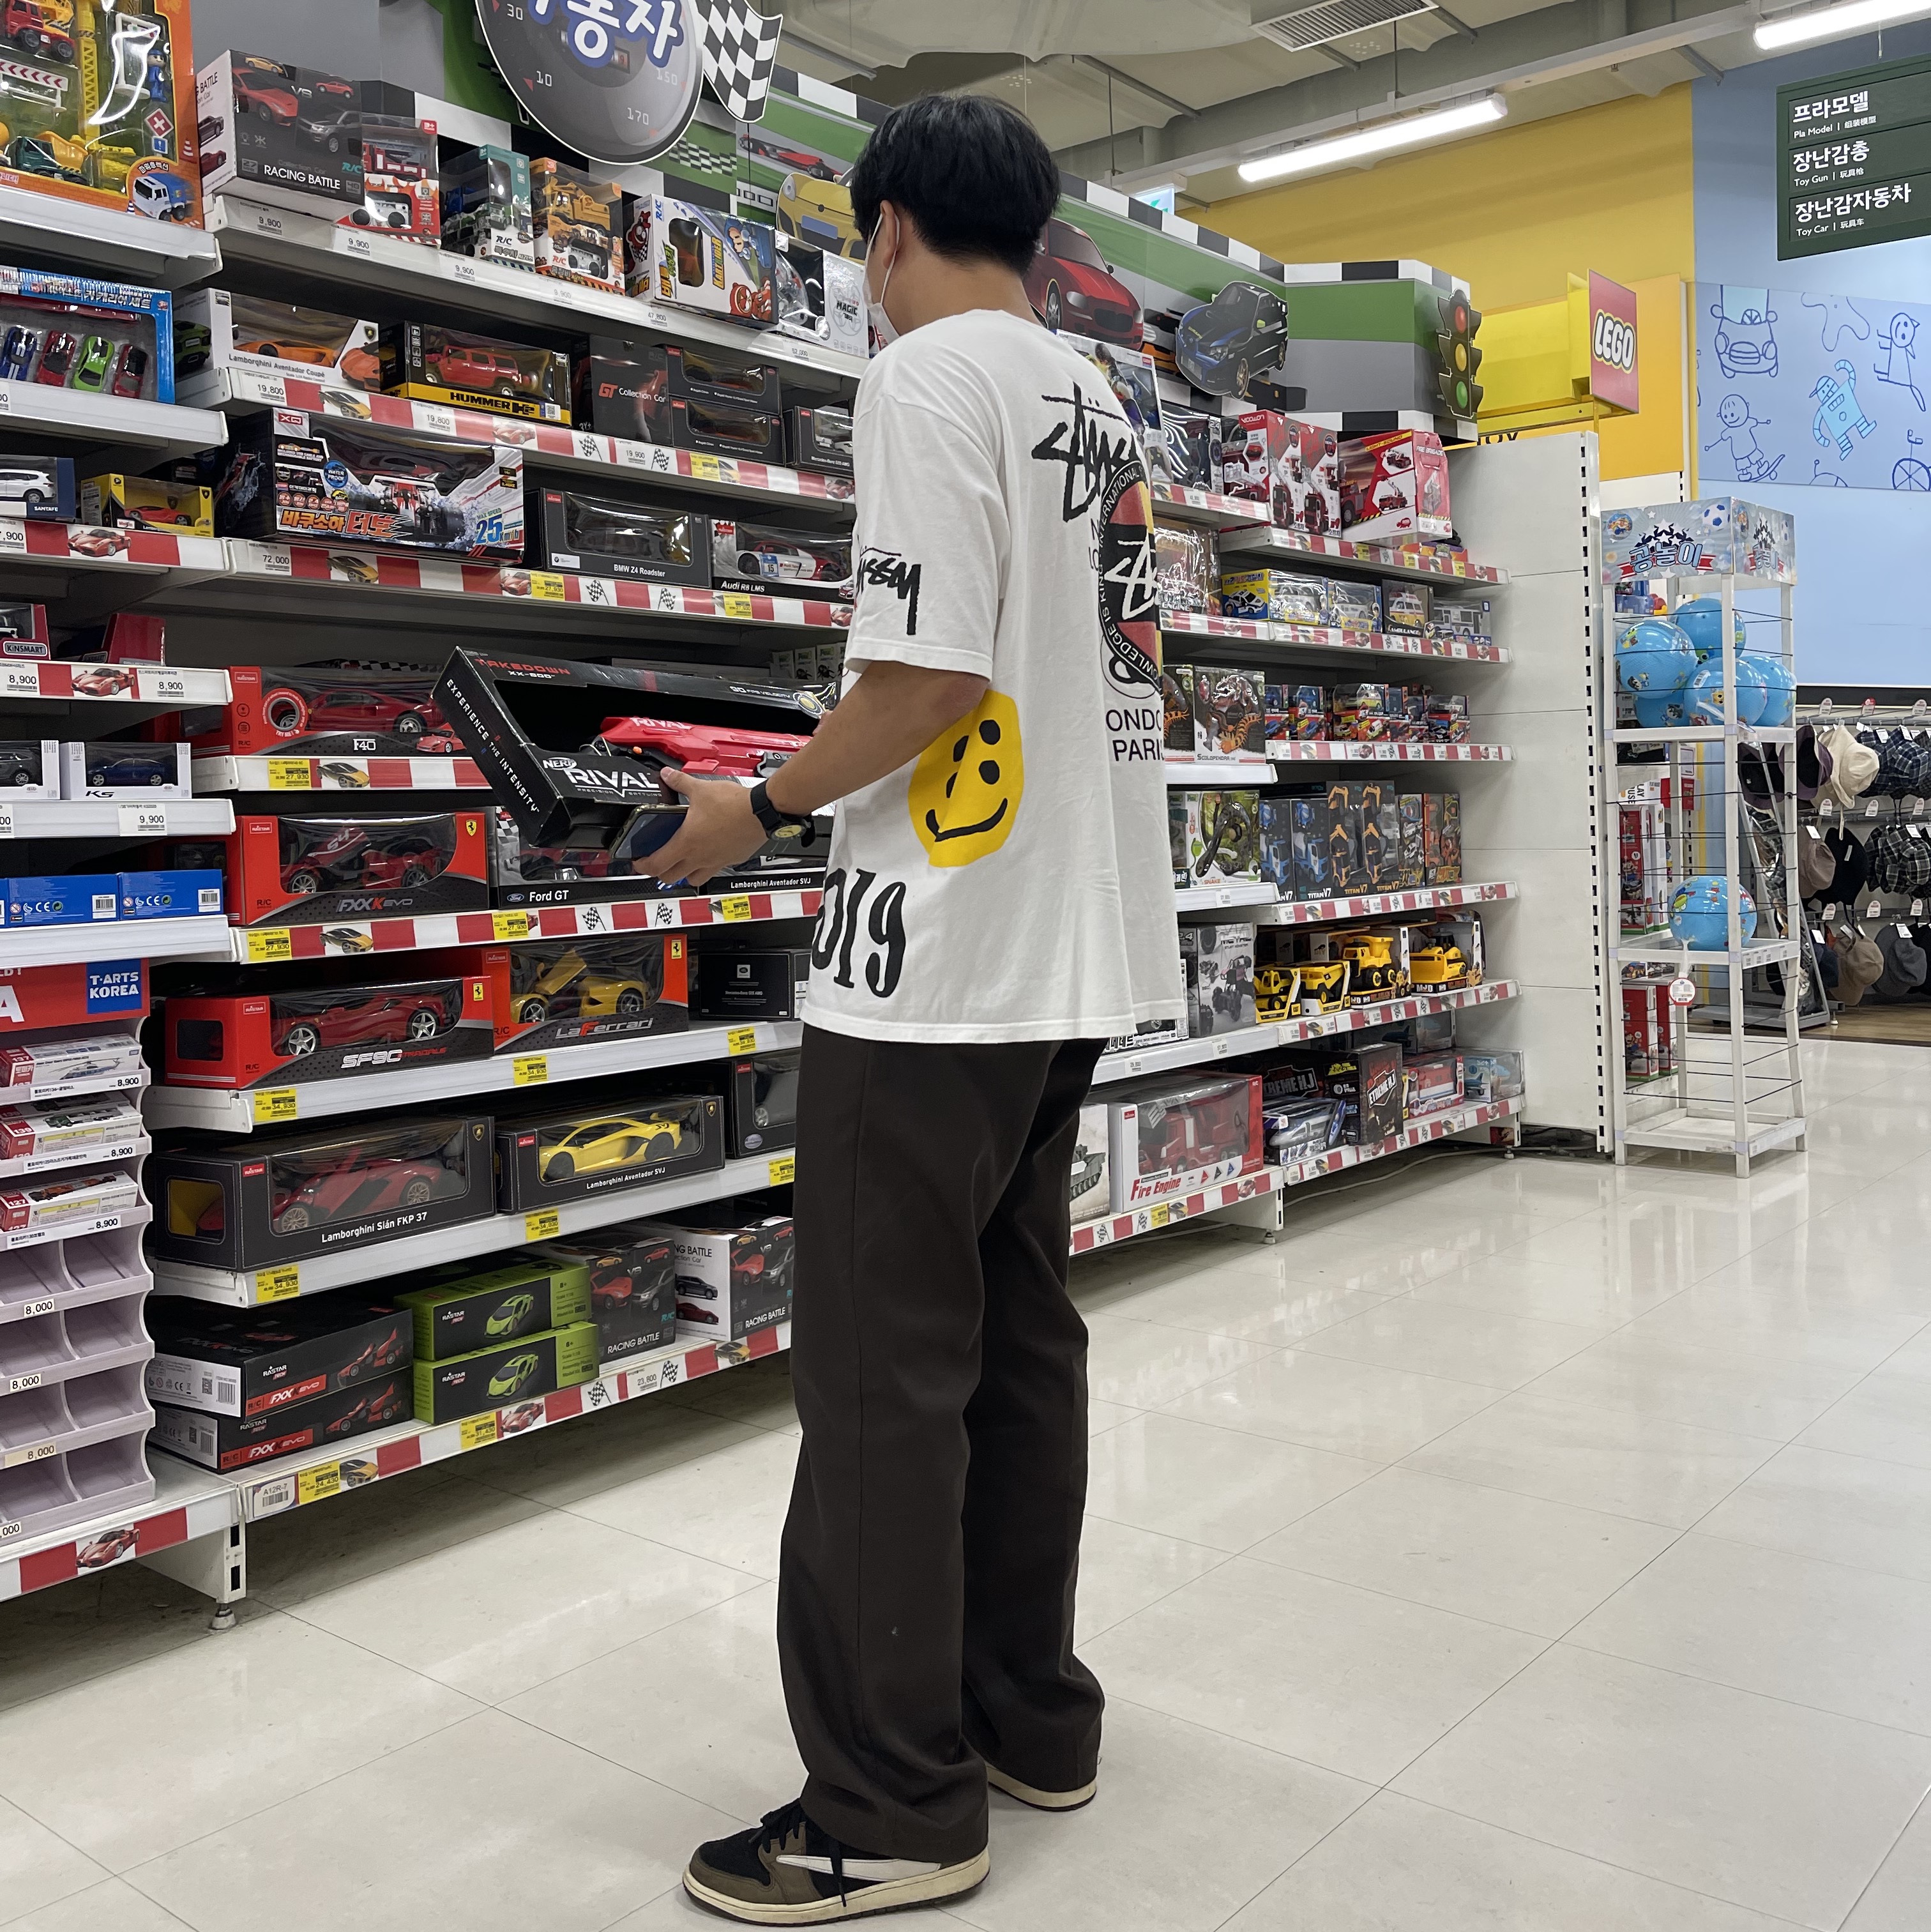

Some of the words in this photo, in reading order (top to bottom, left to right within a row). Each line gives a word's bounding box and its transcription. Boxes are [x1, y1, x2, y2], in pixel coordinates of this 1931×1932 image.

[507, 4, 523, 20] 30
[200, 72, 218, 94] BATTLE
[536, 70, 552, 87] 10
[656, 68, 678, 86] 150
[1792, 90, 1869, 123] 프라모델
[627, 107, 649, 125] 170
[1808, 124, 1833, 135] Model
[1793, 140, 1870, 172] 장난감총
[264, 164, 306, 181] RACING
[308, 173, 341, 190] BATTLE
[1794, 178, 1810, 187] Toy
[1812, 174, 1829, 184] Gun
[1795, 183, 1912, 223] 장난감자동차
[1796, 228, 1812, 237] Toy
[1814, 224, 1829, 234] Car
[496, 235, 512, 245] R/C
[552, 255, 566, 265] R/C
[837, 302, 858, 317] MAGIC
[1594, 315, 1635, 369] LEGO
[229, 353, 273, 370] Lamborghini
[274, 362, 305, 374] Aventador
[307, 367, 326, 378] Coupé
[257, 384, 284, 395] 19,800
[599, 383, 618, 399] GT
[619, 387, 652, 402] Collection
[653, 393, 667, 403] Car
[450, 392, 511, 411] HUMMER
[427, 414, 450, 425] 19,800
[489, 508, 503, 517] SPEED
[281, 509, 346, 532] 바쿠소하
[346, 512, 409, 538] 터보
[475, 514, 503, 545] 25
[263, 554, 290, 566] 72,000
[1629, 541, 1704, 574] 공놀이
[614, 564, 630, 574] BMW
[630, 566, 639, 575] Z4
[639, 568, 665, 578] Roadster
[721, 580, 739, 590] Audi
[741, 582, 750, 591] R8
[750, 584, 766, 593] LMS
[1162, 601, 1190, 612] ENGINE
[474, 658, 572, 676] TAKEDOWN
[9, 674, 37, 686] 8,900
[159, 681, 183, 692] 8,900
[629, 717, 693, 731] RIVAL
[353, 738, 377, 751] F40
[446, 679, 490, 741] EXPERIENCE
[488, 741, 501, 758] THE
[499, 757, 540, 813] INTENSITY
[1112, 738, 1164, 761] PARI
[543, 757, 577, 770] NERF
[561, 767, 661, 789] RIVAL
[576, 787, 614, 795] PRECISION
[139, 815, 164, 825] 9,900
[731, 881, 768, 890] Lamborghini
[769, 879, 799, 888] Aventador
[529, 890, 552, 902] Ford
[554, 890, 569, 901] GT
[1307, 890, 1324, 899] TITAN
[1323, 887, 1331, 898] V7
[89, 984, 139, 999] KOREA
[556, 1017, 654, 1040] LaFerrari
[340, 1049, 404, 1069] SF90
[245, 1063, 260, 1072] R/C
[117, 1077, 139, 1087] 8,900
[272, 1102, 296, 1111] 34,930
[111, 1146, 133, 1157] 8,900
[587, 1176, 623, 1189] Lamborghini
[624, 1170, 655, 1182] Aventador
[655, 1166, 665, 1175] SVJ
[1130, 1178, 1151, 1201] Fire
[1153, 1177, 1182, 1196] Engine
[96, 1218, 118, 1229] 8,900
[321, 1225, 376, 1244] Lamborghini
[376, 1220, 396, 1232] Sián
[397, 1215, 415, 1228] FKP
[416, 1212, 428, 1224] 37
[687, 1246, 712, 1258] BATTLE
[692, 1255, 702, 1263] Car
[274, 1280, 299, 1289] 34,930
[26, 1301, 54, 1315] 8,000
[442, 1309, 465, 1321] RASTAR
[745, 1314, 768, 1330] RACING
[768, 1307, 786, 1320] BATTLE
[607, 1337, 636, 1355] RACING
[637, 1332, 660, 1346] BATTLE
[262, 1365, 287, 1377] RASTAR
[442, 1371, 466, 1382] RASTAR
[11, 1374, 40, 1390] 8,000
[239, 1419, 267, 1431] RASTAR
[27, 1445, 56, 1460] 8,000
[262, 1482, 288, 1496] A12R-7
[315, 1476, 339, 1488] 24,430
